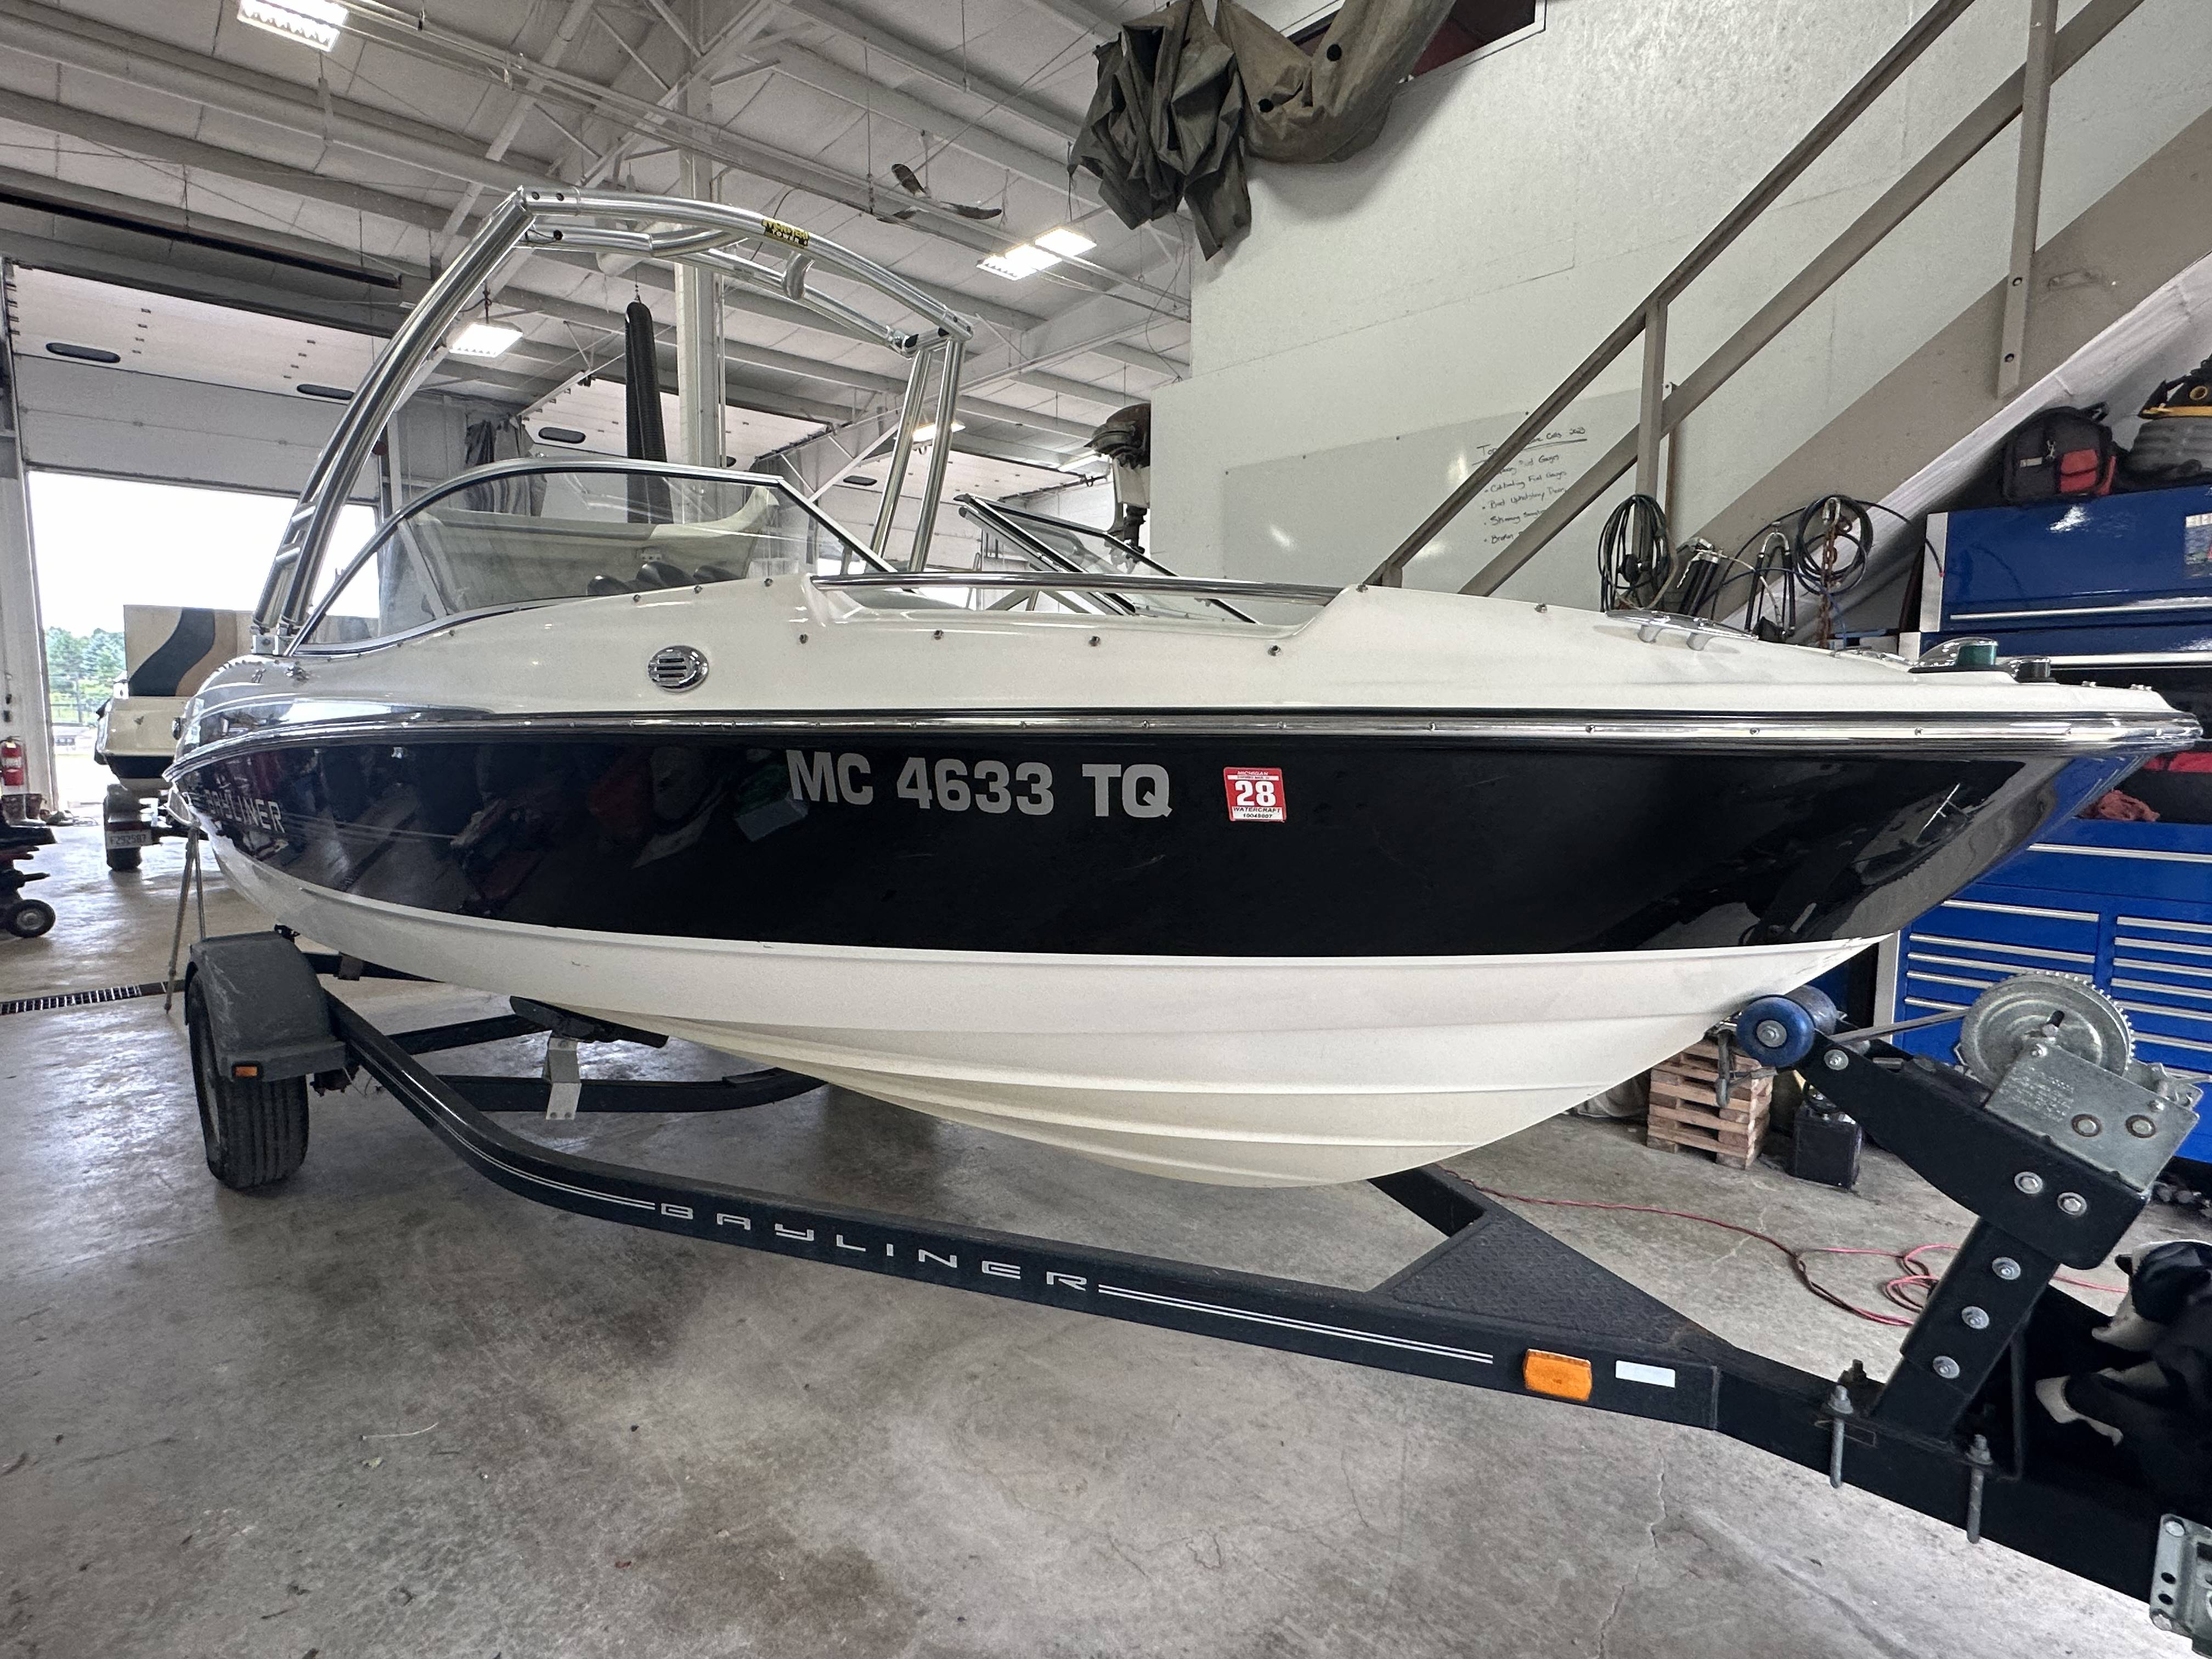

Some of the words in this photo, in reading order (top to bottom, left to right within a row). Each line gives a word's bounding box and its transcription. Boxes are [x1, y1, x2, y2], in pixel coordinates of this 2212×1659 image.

[786, 749, 873, 805] MC
[896, 757, 1054, 815] 4633
[1082, 764, 1172, 817] TQ
[1235, 780, 1276, 806] 28
[661, 1203, 1087, 1291] BAYLINER
